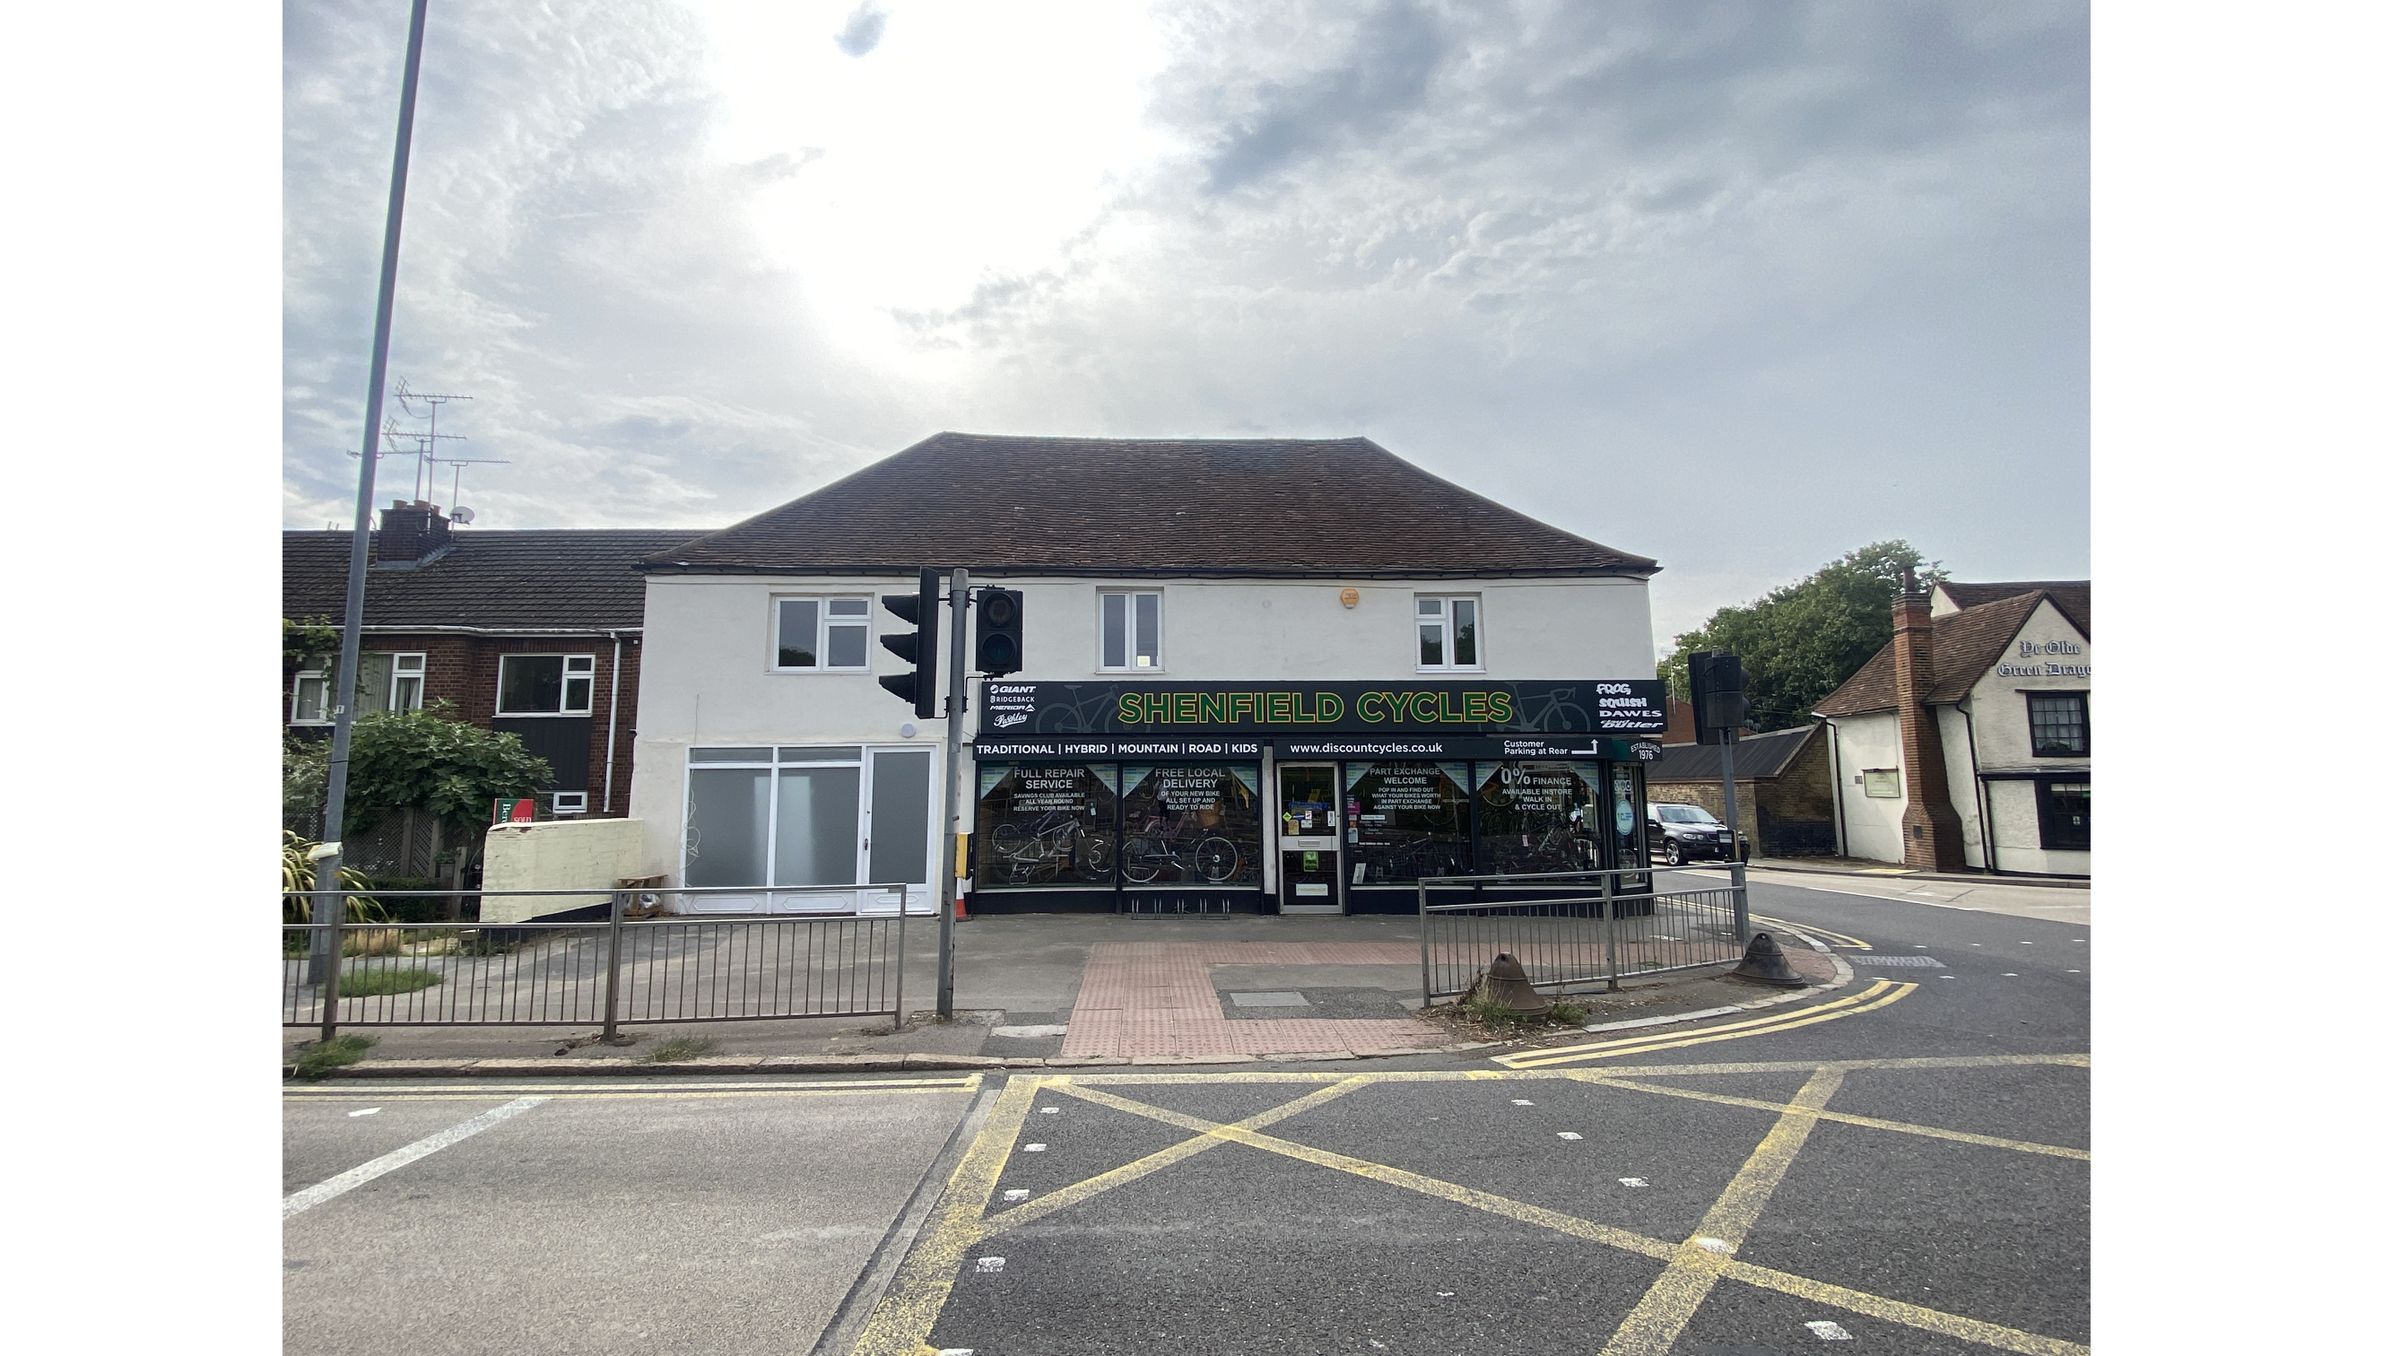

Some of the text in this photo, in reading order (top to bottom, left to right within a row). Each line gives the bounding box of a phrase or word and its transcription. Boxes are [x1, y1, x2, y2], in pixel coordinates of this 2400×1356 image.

[2020, 640, 2081, 658] Ye Olde
[1998, 663, 2042, 677] Green
[1596, 683, 1632, 695] FROG
[1118, 691, 1512, 723] SHENFIELD CYCLES
[1599, 697, 1647, 708] SQUISH
[1290, 742, 1443, 755] www.discountcycles.co.uk
[1504, 740, 1545, 748] Customer
[1630, 742, 1661, 754] ESTABLISHED
[976, 745, 1258, 754] TRADITIONAL HYBRID MOUNTAIN ROAD KIDS
[1504, 747, 1535, 756] Parking
[1549, 747, 1569, 755] Rear
[1639, 750, 1653, 760] 1976
[1014, 769, 1085, 778] FULL REPAIR
[1155, 768, 1226, 778] FREE LOCAL
[1370, 767, 1441, 775] PART EXCHANGE
[1384, 776, 1427, 784] WELCOME
[1501, 768, 1531, 784] 0%
[1533, 777, 1572, 785] FINANCE
[1025, 779, 1073, 789] SERVICE
[1163, 779, 1218, 788] DELIVERY
